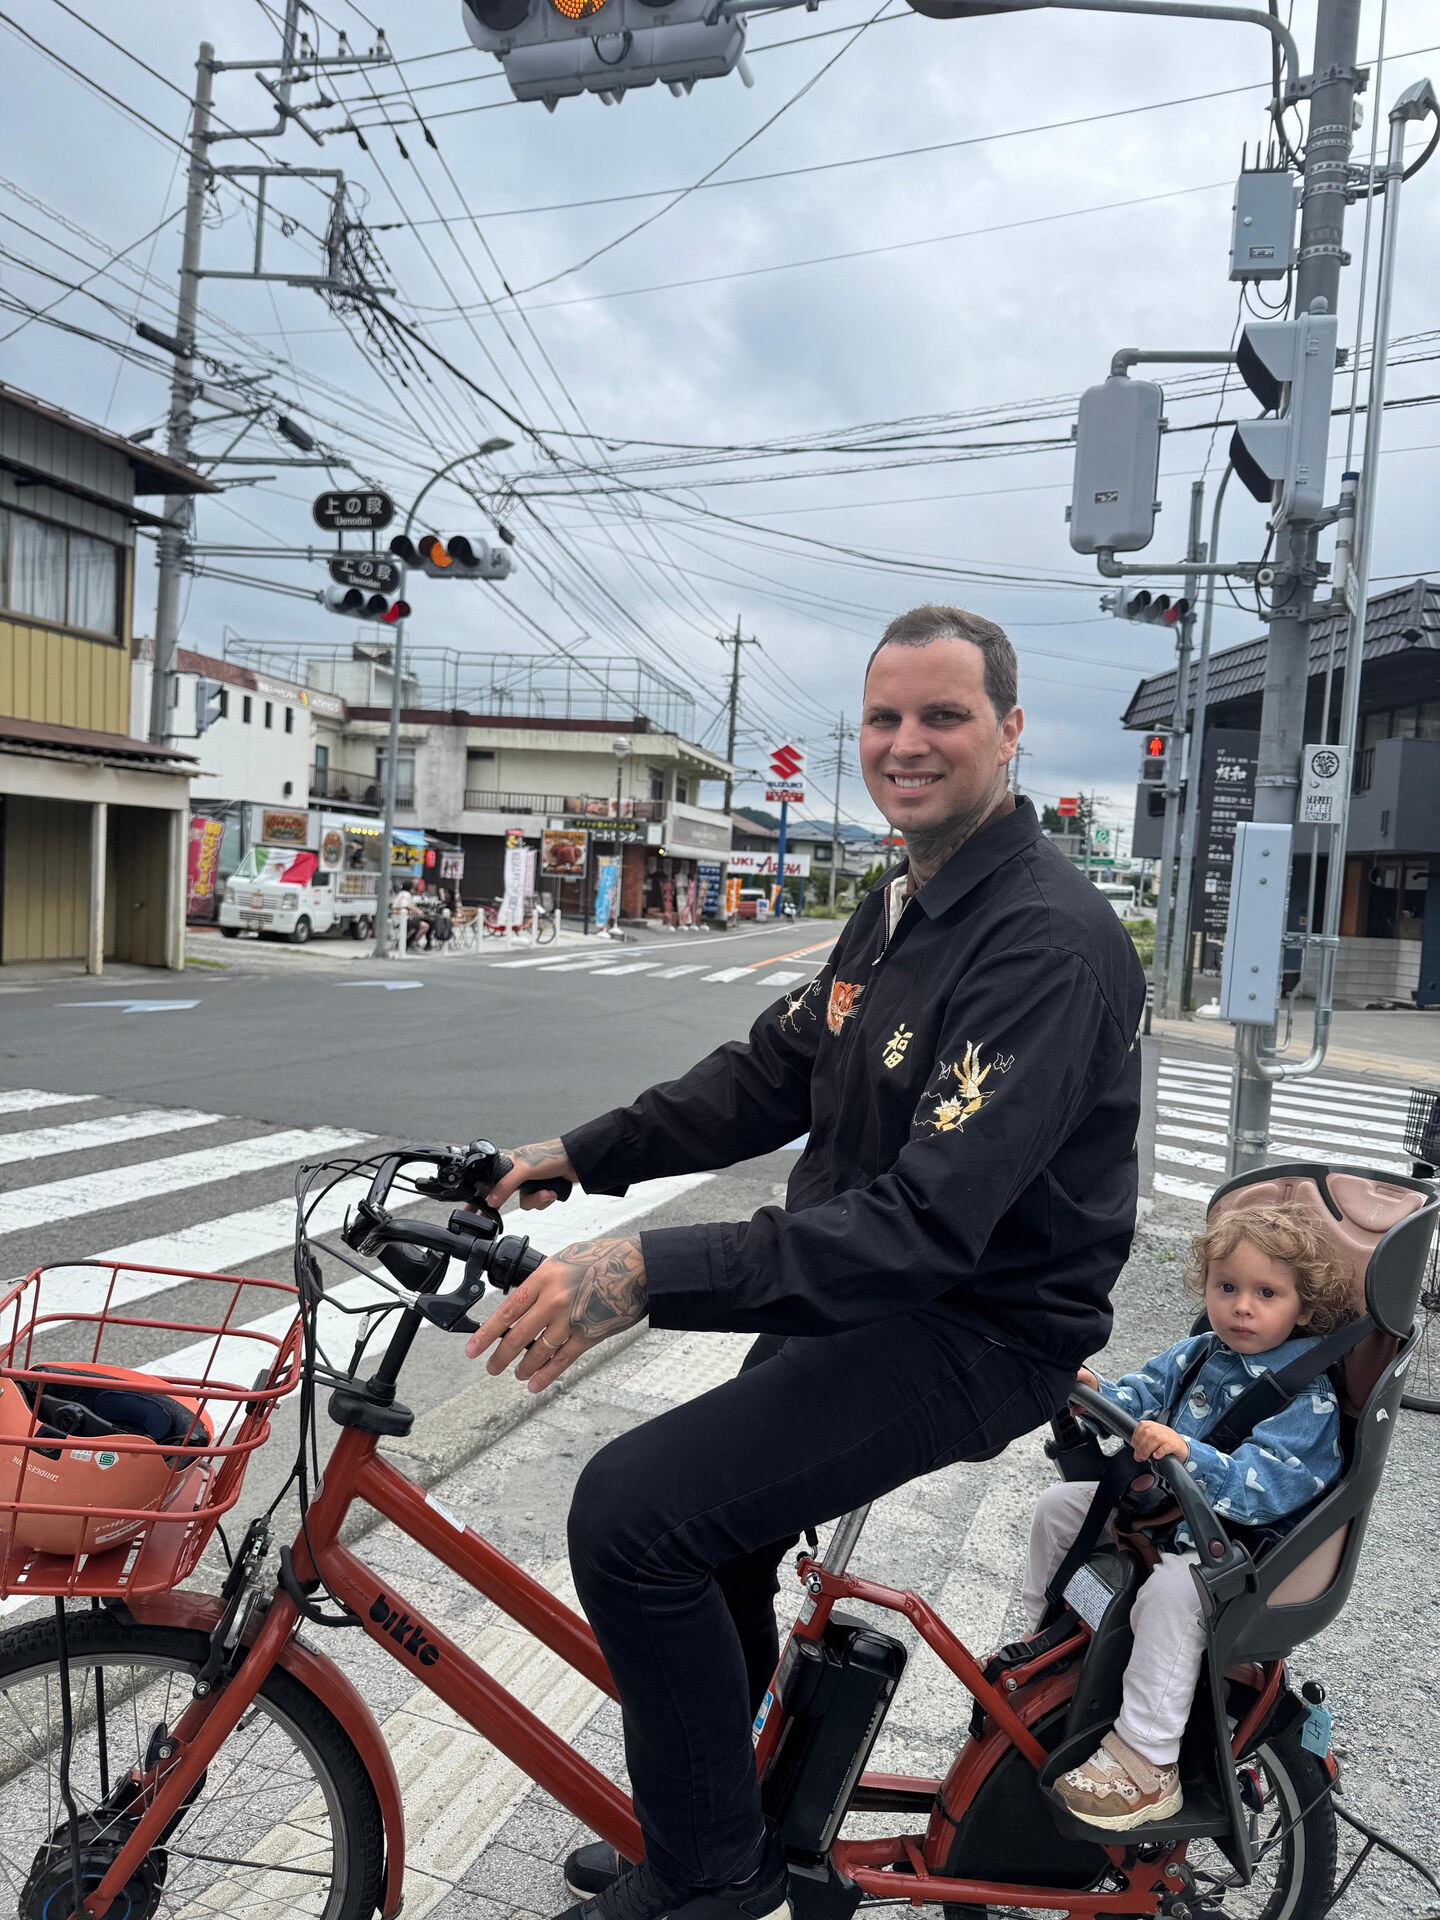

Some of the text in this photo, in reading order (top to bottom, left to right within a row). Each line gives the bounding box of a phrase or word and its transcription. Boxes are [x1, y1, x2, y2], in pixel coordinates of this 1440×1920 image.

[324, 496, 382, 515] 上の段
[340, 561, 392, 581] 上の段
[768, 781, 803, 789] SUZUKI
[11, 1455, 60, 1483] BRIDGESNE
[369, 1592, 440, 1666] bikke
[1308, 1719, 1325, 1741] 47
